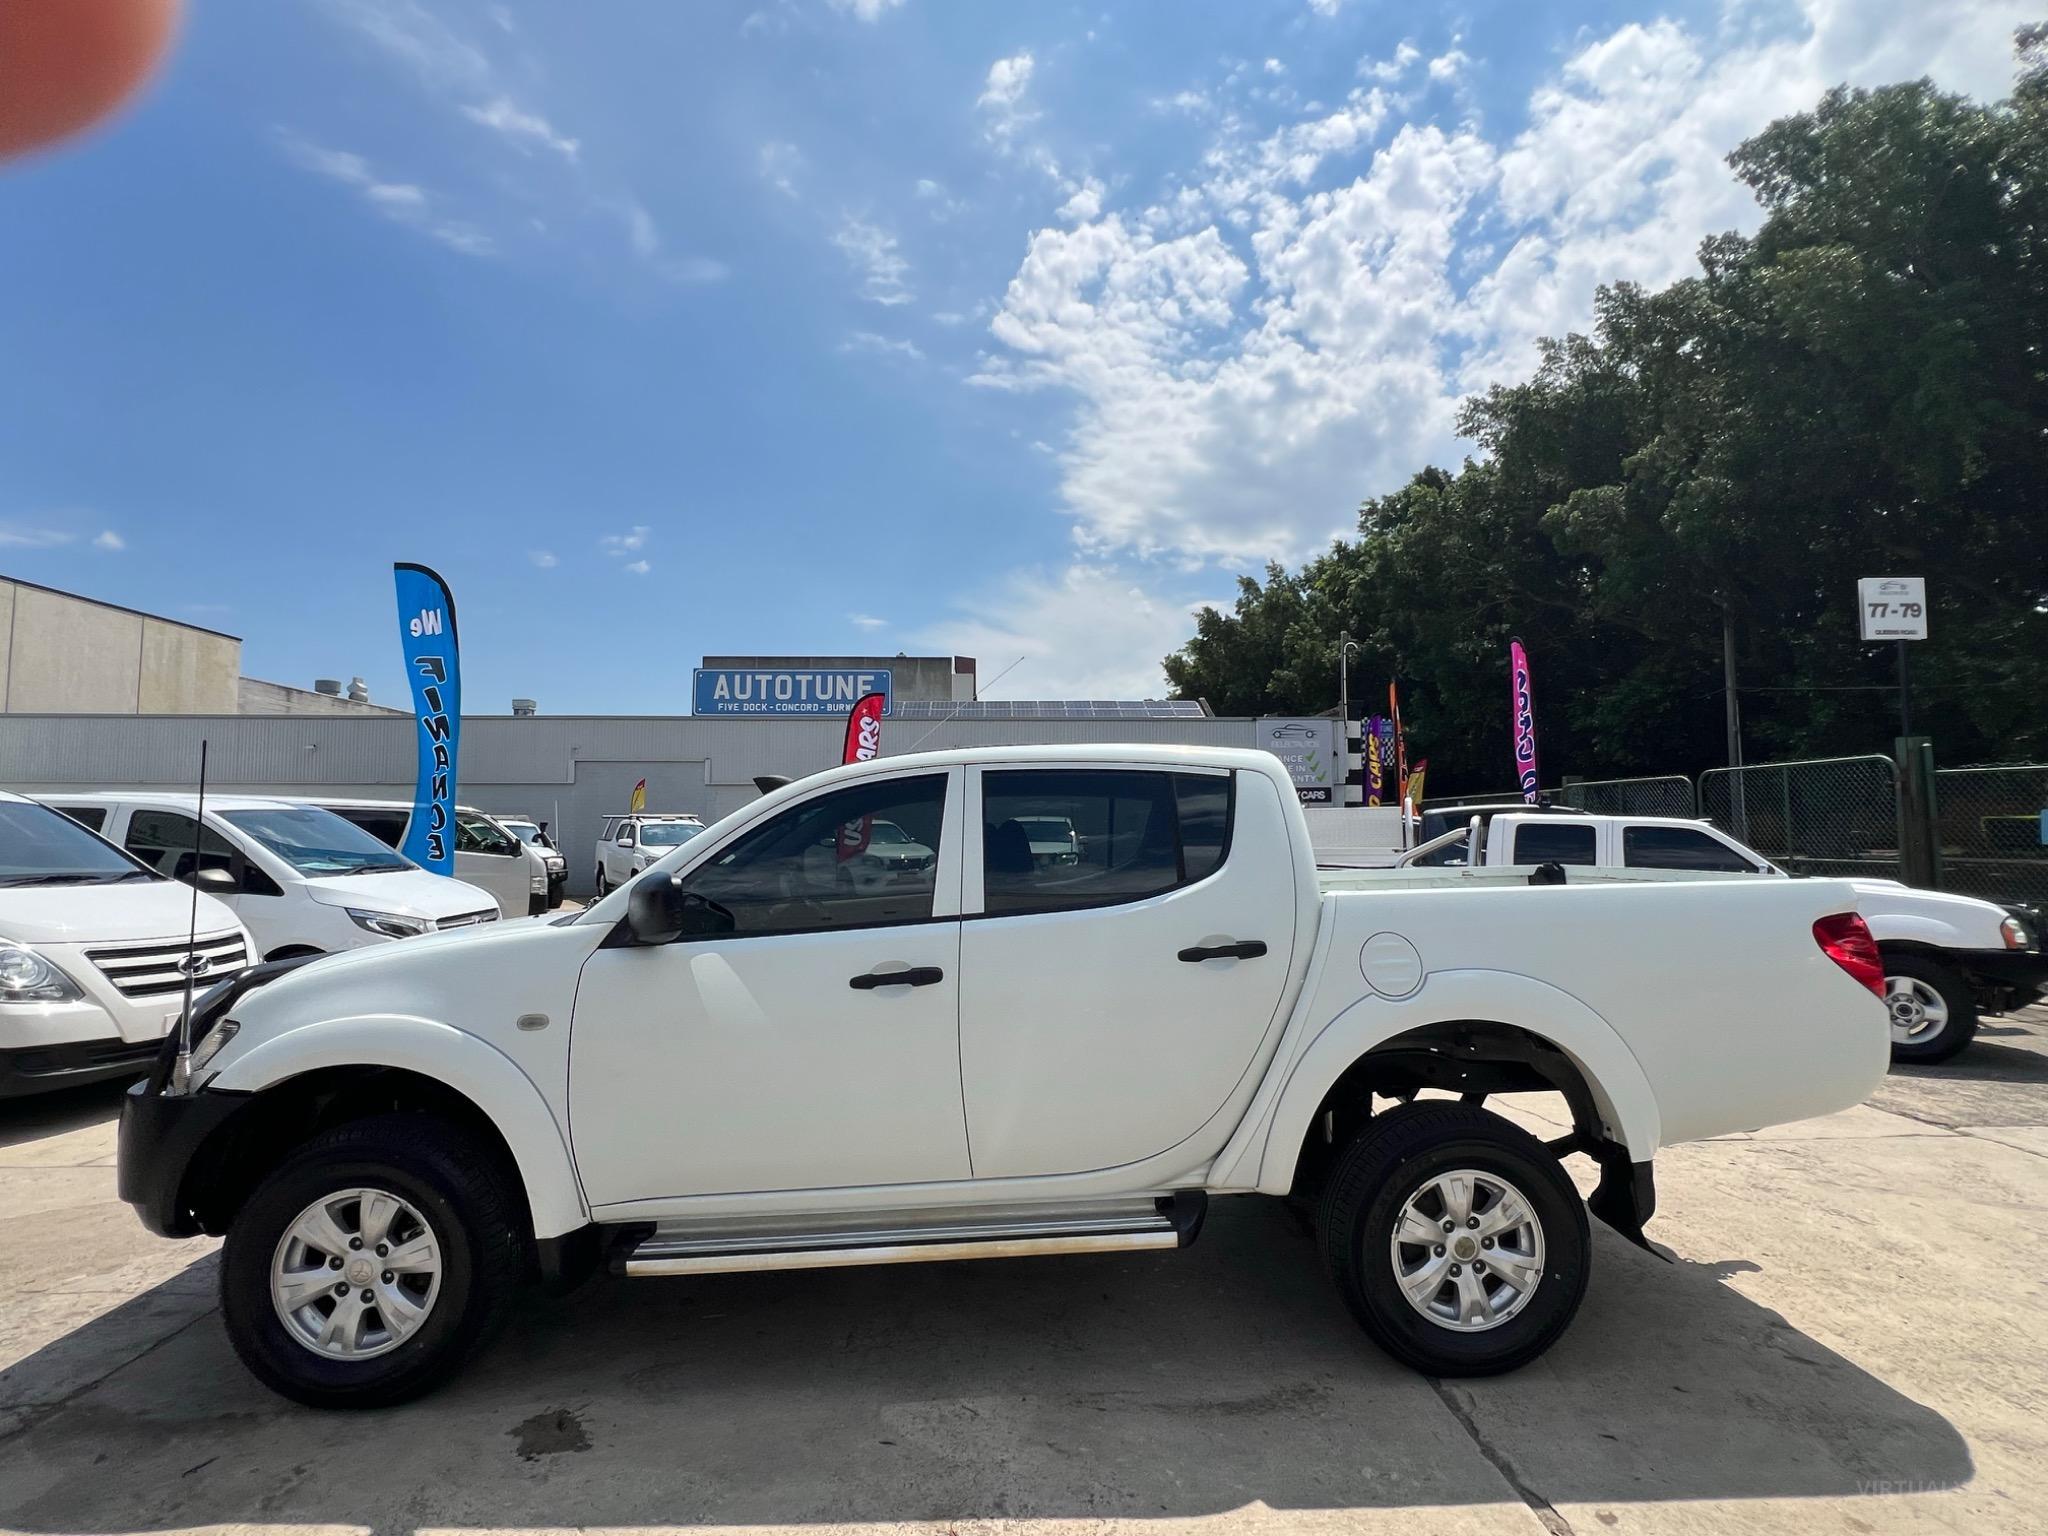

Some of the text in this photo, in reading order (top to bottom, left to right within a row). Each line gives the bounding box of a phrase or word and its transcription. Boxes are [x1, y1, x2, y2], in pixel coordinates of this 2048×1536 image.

[1868, 603, 1889, 618] 77
[1900, 602, 1922, 618] 79
[713, 674, 875, 700] AUTOTUNE
[718, 703, 740, 711] FIVE
[743, 703, 768, 711] DOCK
[775, 703, 819, 711] CONCORD
[1368, 733, 1382, 790] CARS
[1301, 791, 1326, 800] CARS
